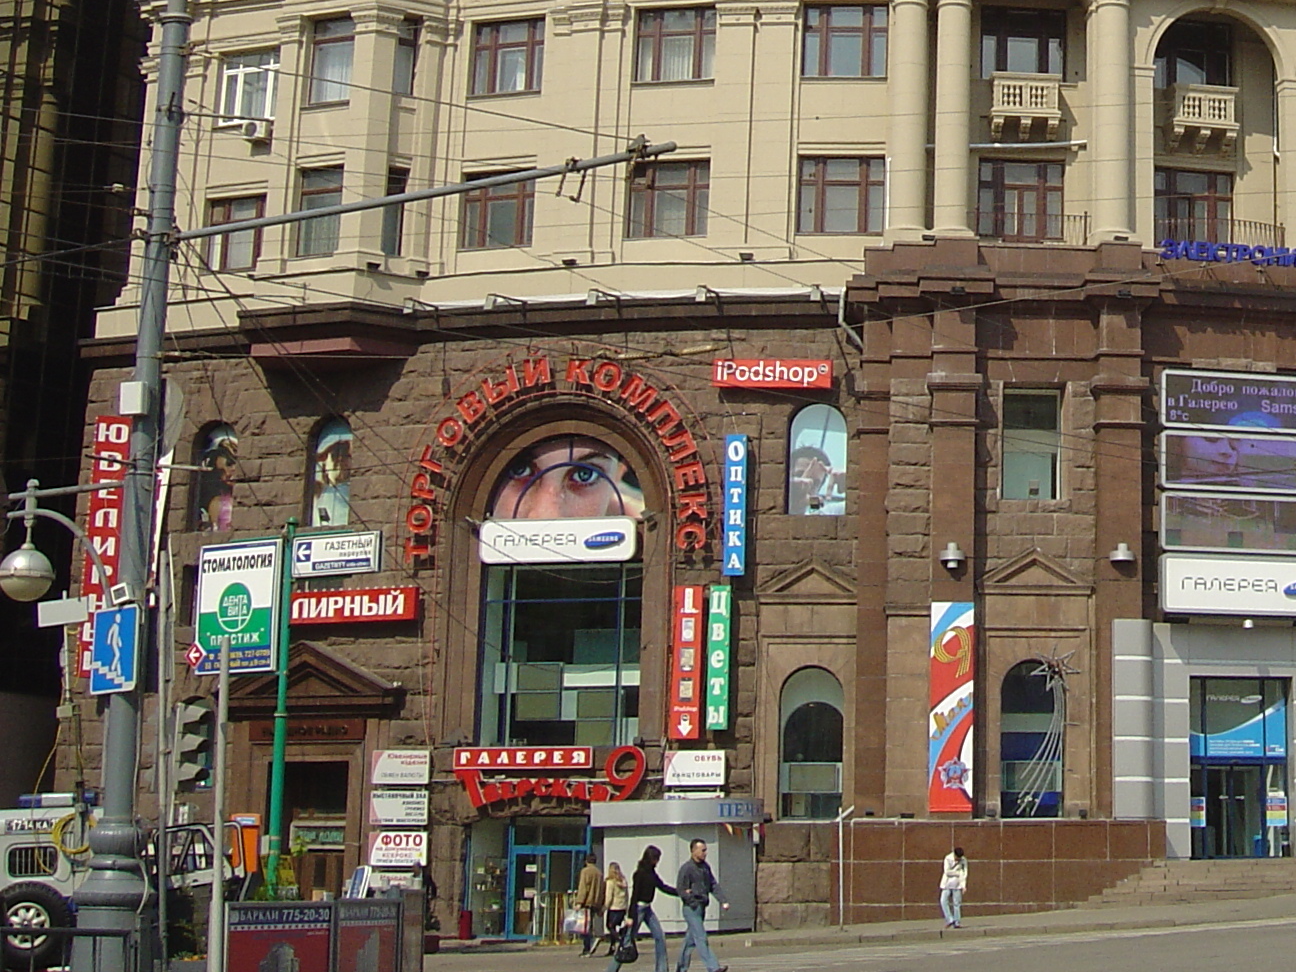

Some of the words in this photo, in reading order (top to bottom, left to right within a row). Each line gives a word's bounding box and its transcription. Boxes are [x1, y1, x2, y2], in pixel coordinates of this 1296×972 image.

[717, 361, 818, 387] iPodshop
[1191, 379, 1235, 396] Добро
[1179, 395, 1238, 412] Галерею
[404, 347, 552, 564] ТОРГОВЫЙ
[566, 359, 708, 550] КОМПЛЕКС
[727, 440, 745, 569] ОПТИКА
[324, 537, 373, 551] ГАЗЕТНЫЙ
[493, 533, 577, 547] ГАЛЕРЕЯ
[202, 553, 273, 574] СТОМАТОЛОГИЯ
[1181, 577, 1278, 593] ГАЛЕРЕЯ
[292, 589, 404, 620] ЛИРНЫЙ
[460, 750, 586, 765] ГАЛЕРЕЯ
[605, 745, 647, 802] 9
[381, 834, 422, 847] ФОТО
[282, 908, 330, 921] 775-20-30
